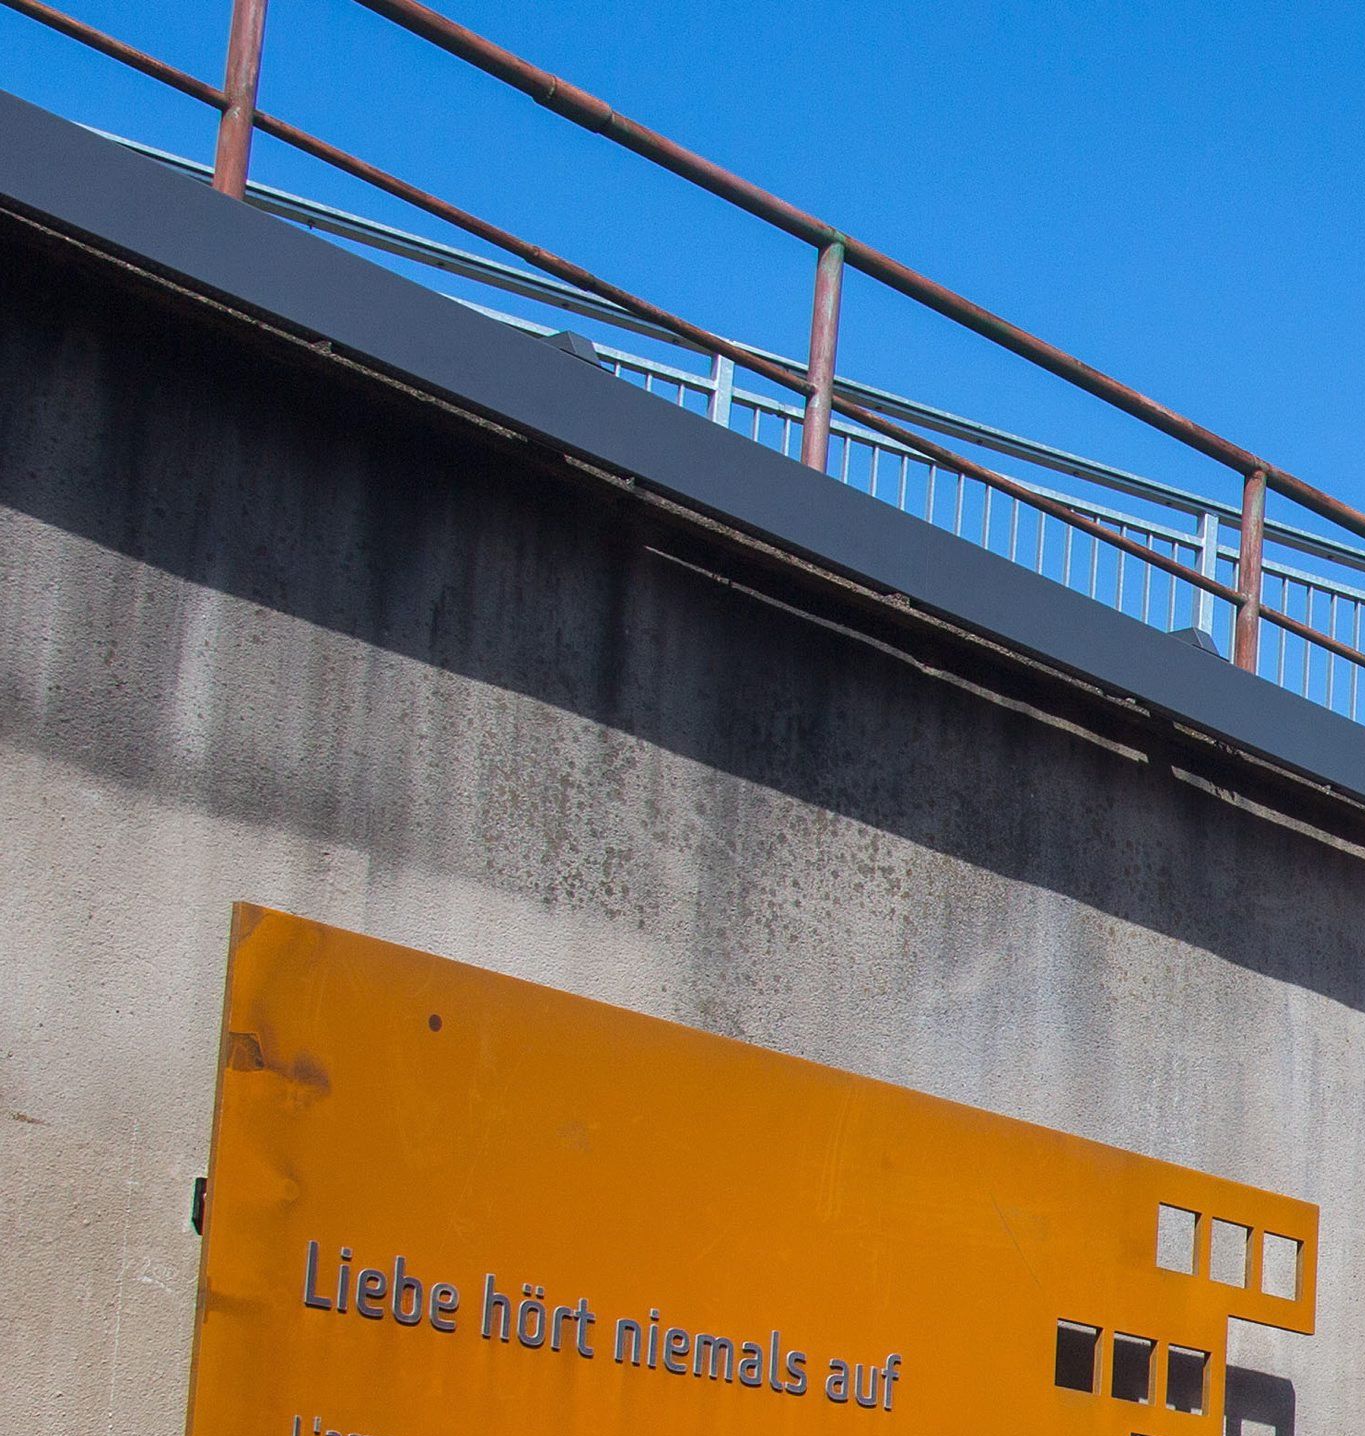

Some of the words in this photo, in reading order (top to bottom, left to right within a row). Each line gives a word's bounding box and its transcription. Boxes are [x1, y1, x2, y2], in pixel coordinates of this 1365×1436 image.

[303, 1240, 459, 1331] Liebe
[481, 1273, 595, 1357] hört
[614, 1309, 807, 1396] niemals
[825, 1353, 902, 1410] auf
